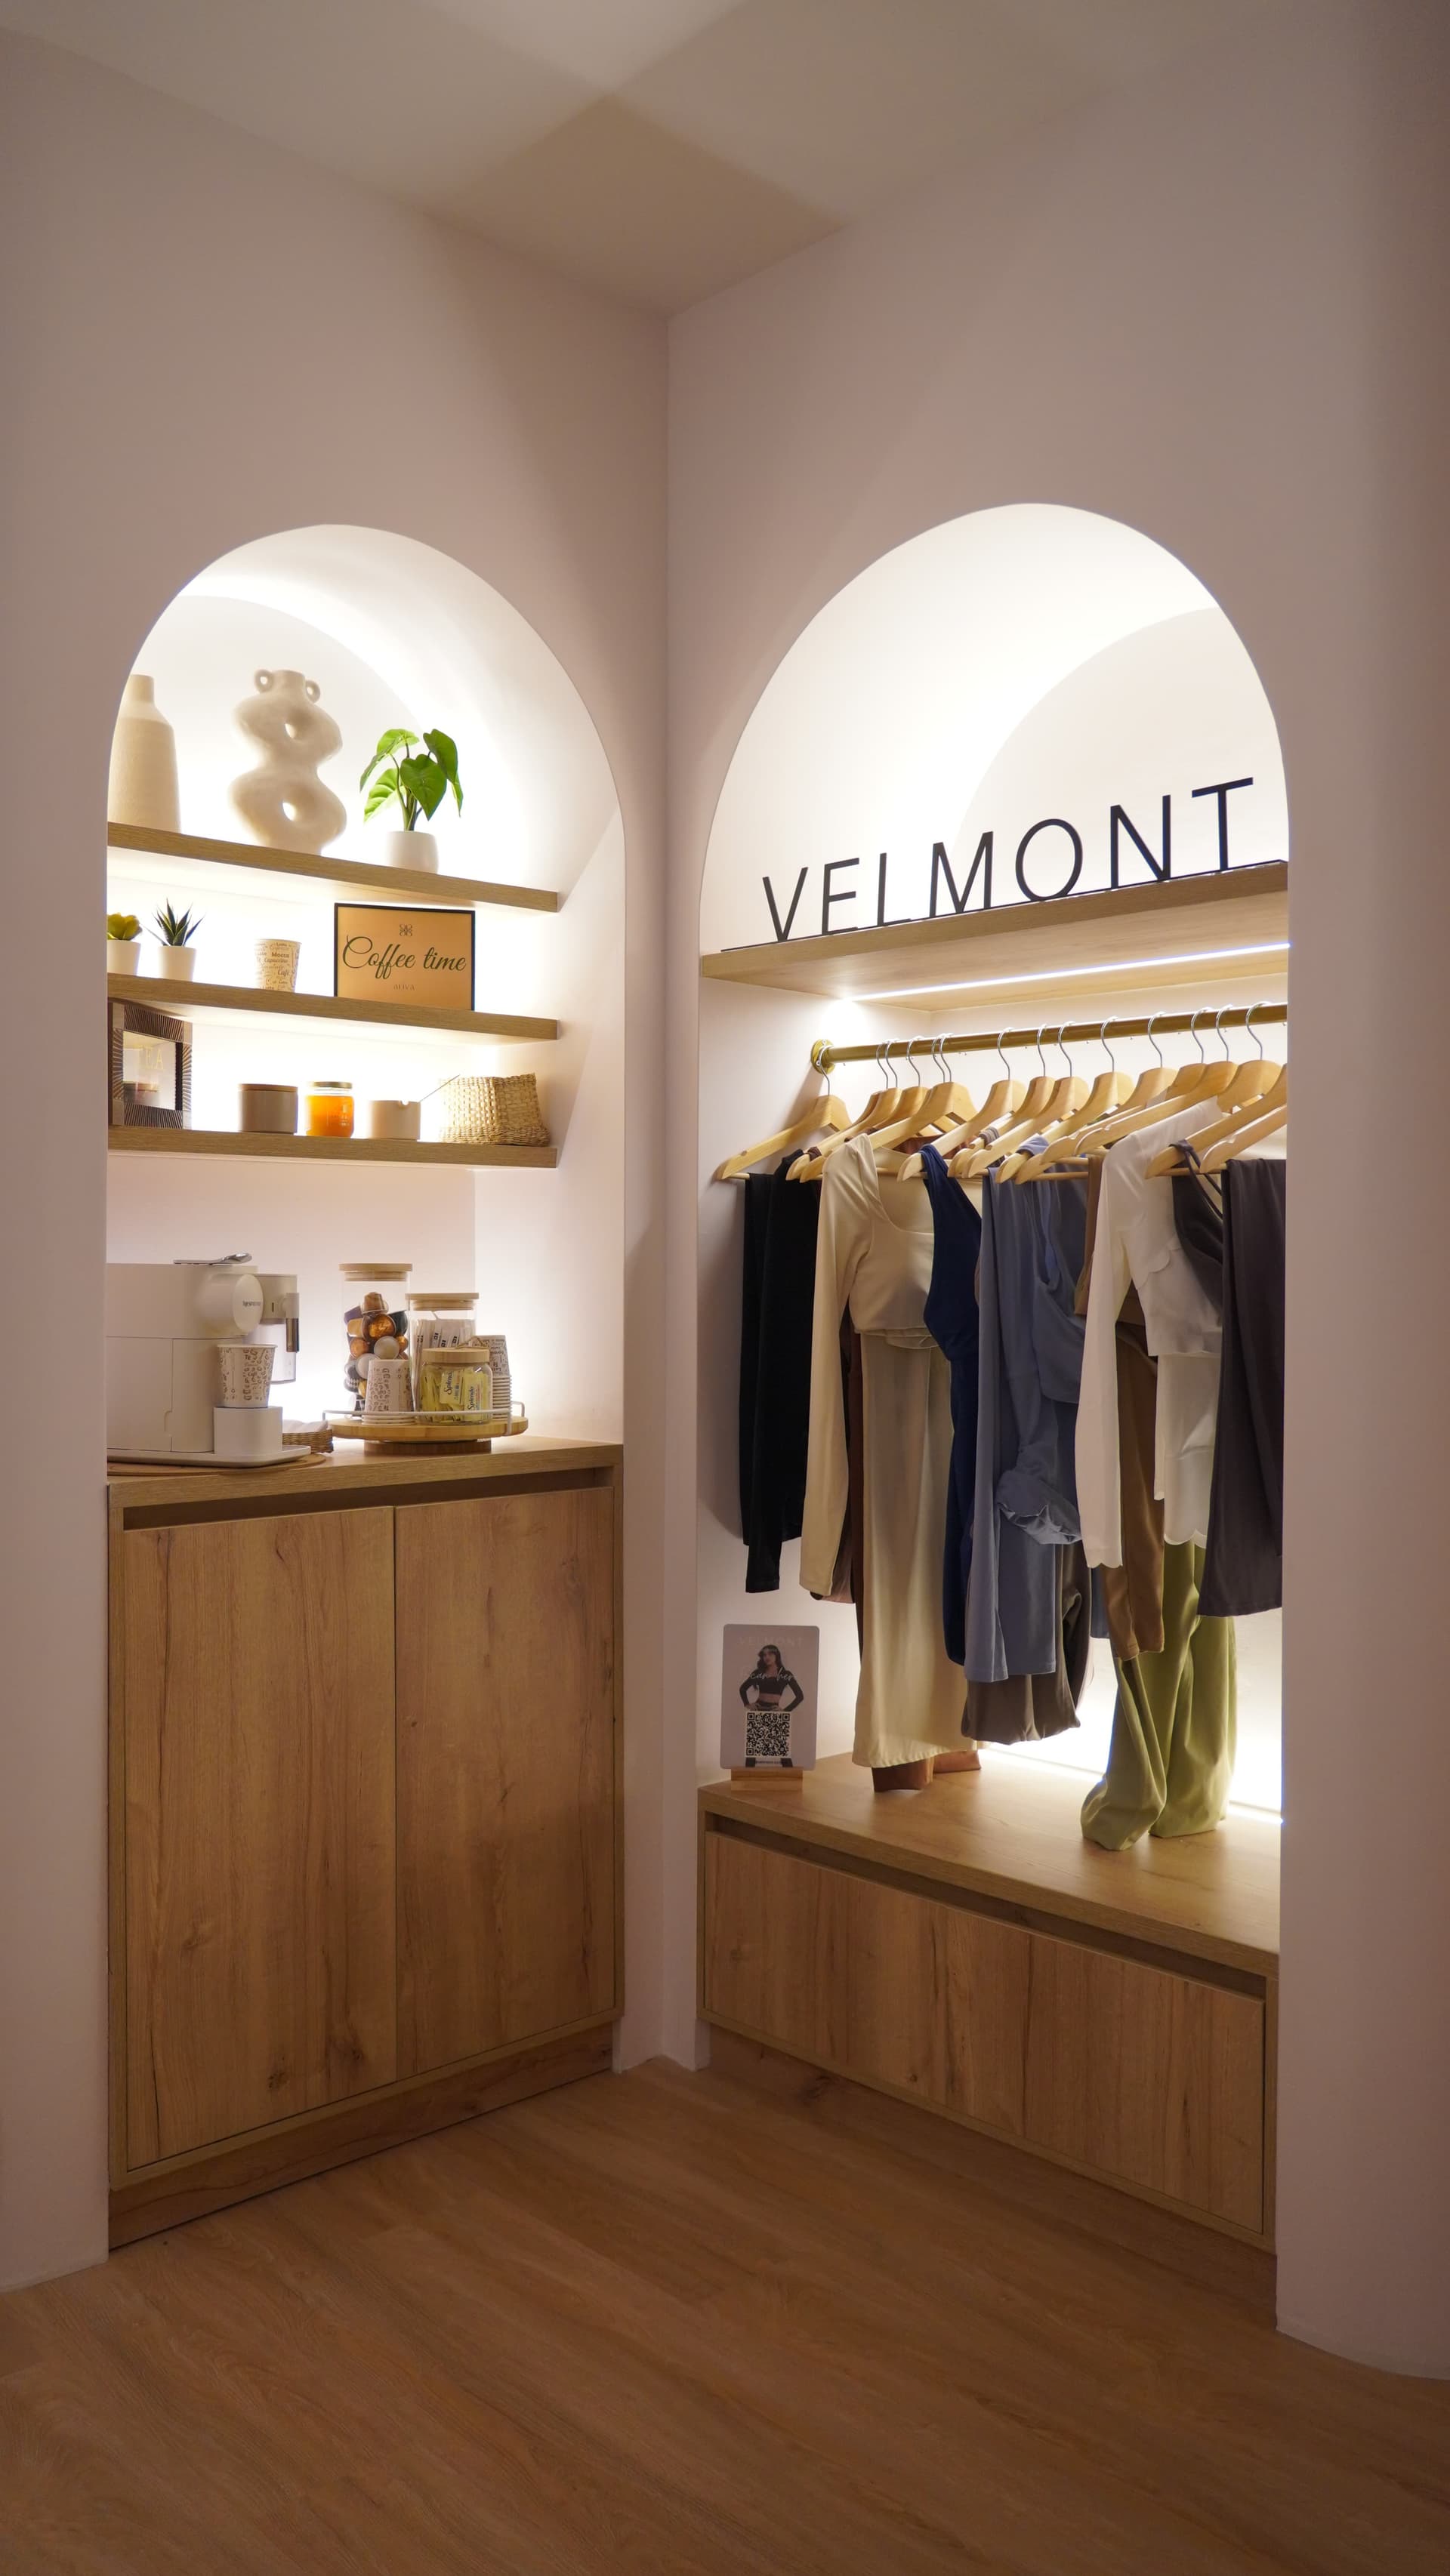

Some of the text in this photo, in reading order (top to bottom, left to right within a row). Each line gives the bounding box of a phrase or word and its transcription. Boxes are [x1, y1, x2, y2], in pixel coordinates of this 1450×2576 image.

[762, 777, 1254, 942] VELMONT
[342, 935, 467, 979] Coffee time
